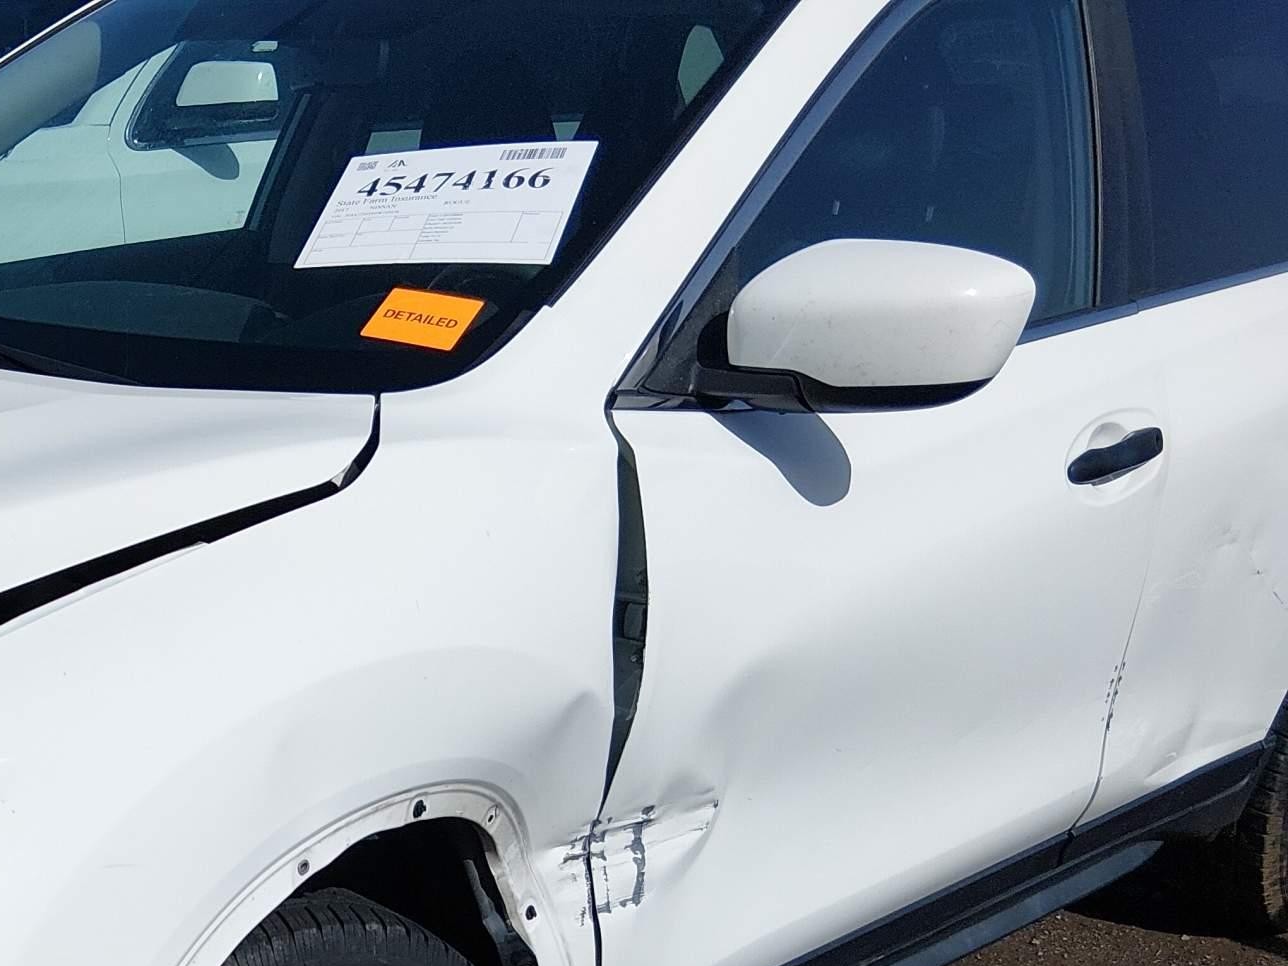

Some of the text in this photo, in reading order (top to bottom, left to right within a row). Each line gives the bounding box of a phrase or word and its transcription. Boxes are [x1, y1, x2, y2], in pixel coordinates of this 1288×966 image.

[357, 168, 555, 197] 45474166
[336, 199, 361, 207] State
[391, 194, 438, 202] Insurance
[383, 308, 458, 329] DETAILED
